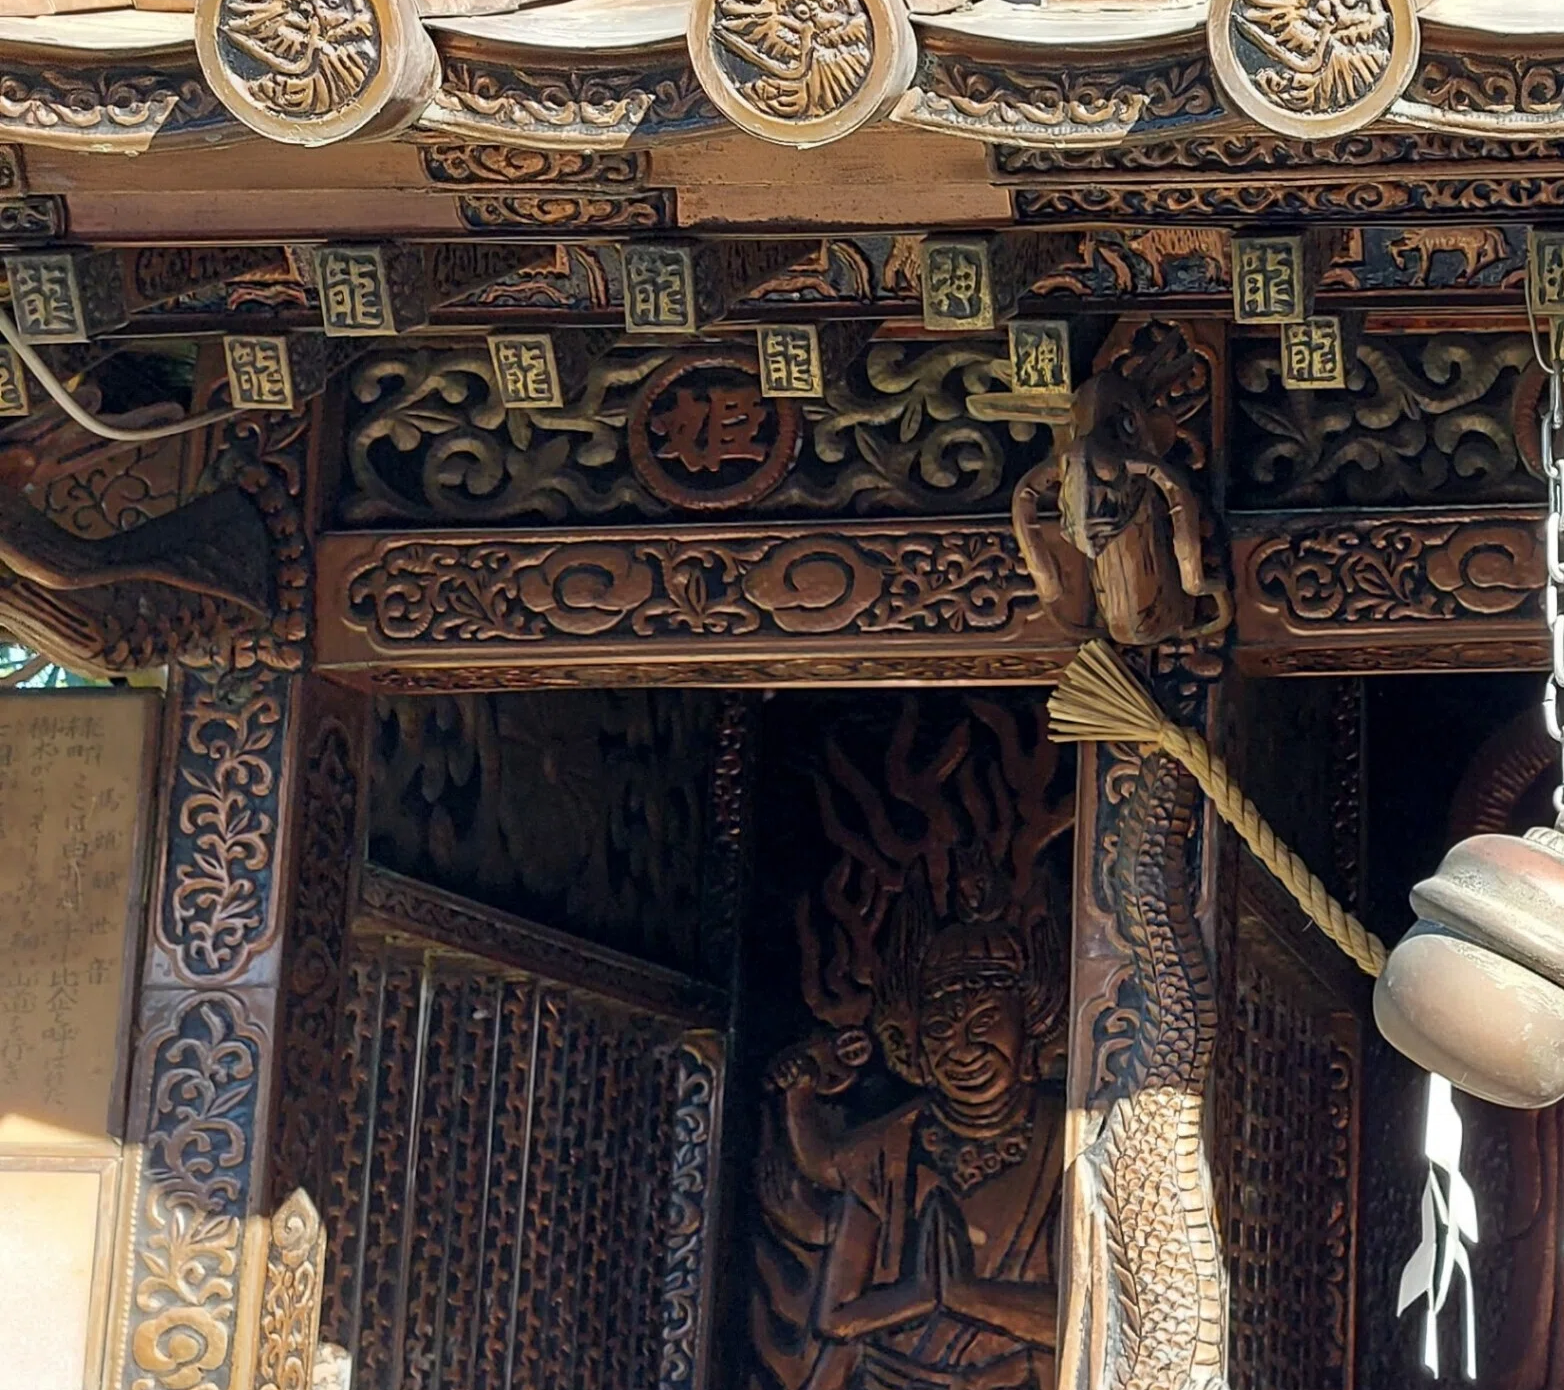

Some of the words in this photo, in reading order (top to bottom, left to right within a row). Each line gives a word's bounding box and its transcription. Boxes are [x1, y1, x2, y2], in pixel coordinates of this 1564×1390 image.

[18, 263, 77, 331] 龍
[327, 253, 383, 326] 龍
[630, 257, 684, 321] 龍
[1244, 247, 1293, 313] 龍
[233, 342, 287, 401] 龍
[500, 343, 549, 401] 龍
[766, 331, 812, 390] 龍
[1289, 323, 1336, 378] 龍
